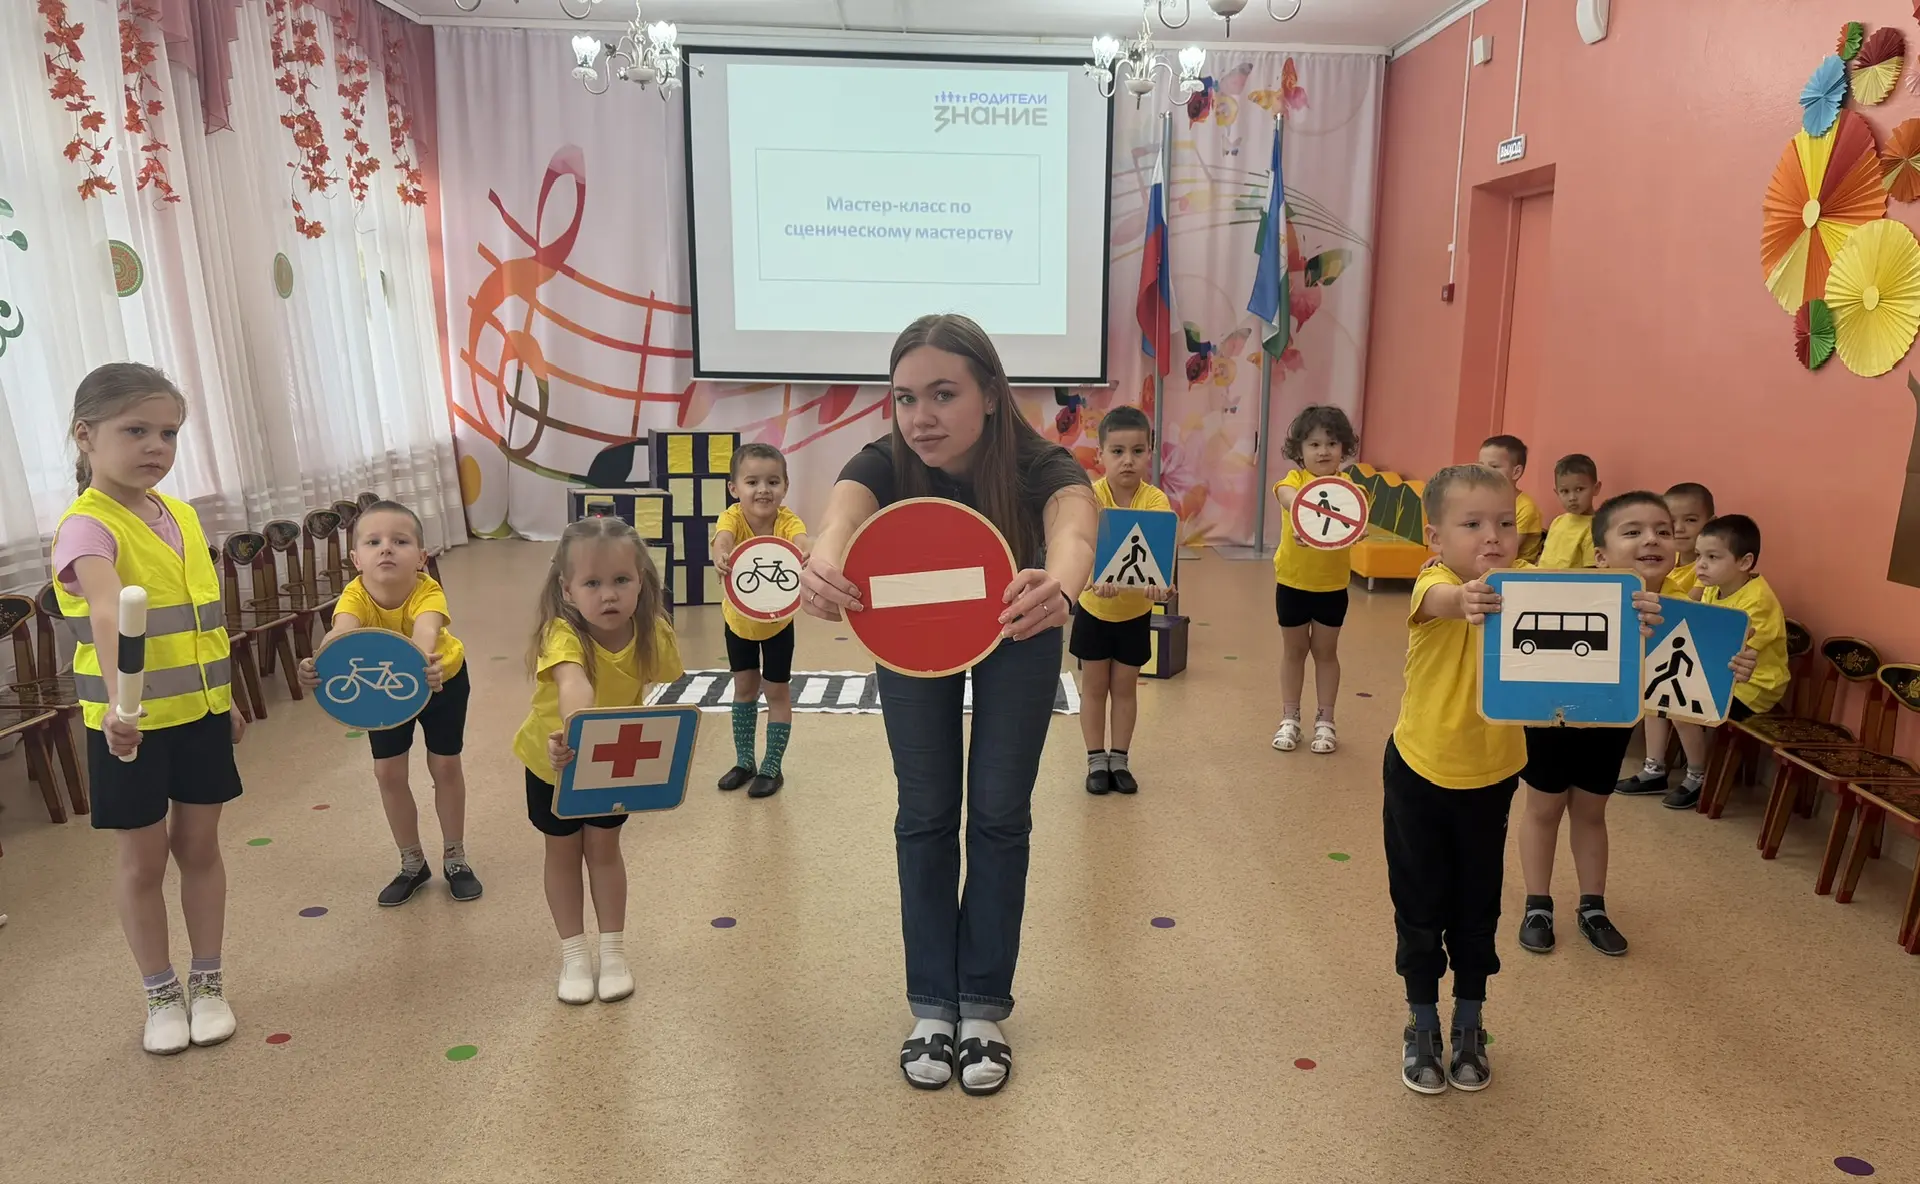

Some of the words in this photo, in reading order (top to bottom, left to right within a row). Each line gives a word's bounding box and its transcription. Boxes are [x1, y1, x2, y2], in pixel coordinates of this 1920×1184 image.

[969, 92, 1047, 105] РОДИТЕЛИ
[1499, 141, 1522, 158] ВЫХОД
[826, 195, 946, 216] Мастер-класс
[950, 202, 971, 214] по
[784, 223, 912, 242] сценическому
[915, 227, 1014, 244] мастерству
